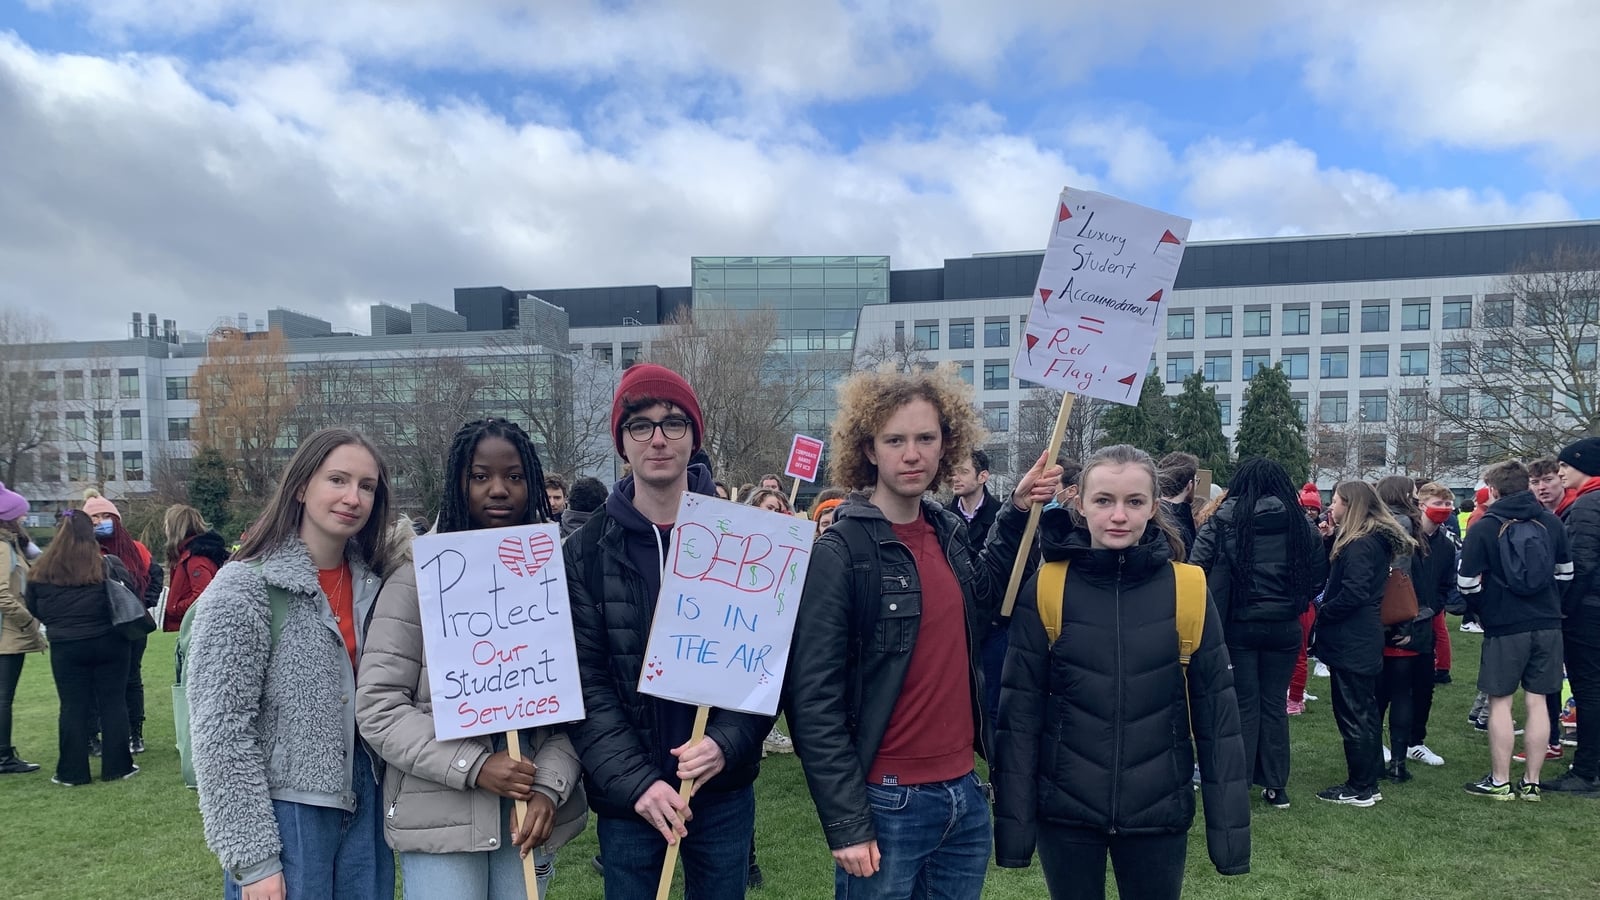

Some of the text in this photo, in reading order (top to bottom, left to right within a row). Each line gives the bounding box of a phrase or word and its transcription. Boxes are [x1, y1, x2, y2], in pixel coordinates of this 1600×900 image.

[1072, 244, 1137, 279] Student
[1047, 328, 1090, 355] Red
[1044, 358, 1108, 391] Flag!
[795, 448, 818, 459] CORPORATE
[673, 522, 809, 599] DEBT
[420, 549, 560, 638] Protect
[677, 593, 759, 632] IS IN
[472, 640, 529, 666] Our
[669, 634, 775, 677] THE AIR
[444, 648, 558, 700] Student
[457, 695, 561, 728] Services
